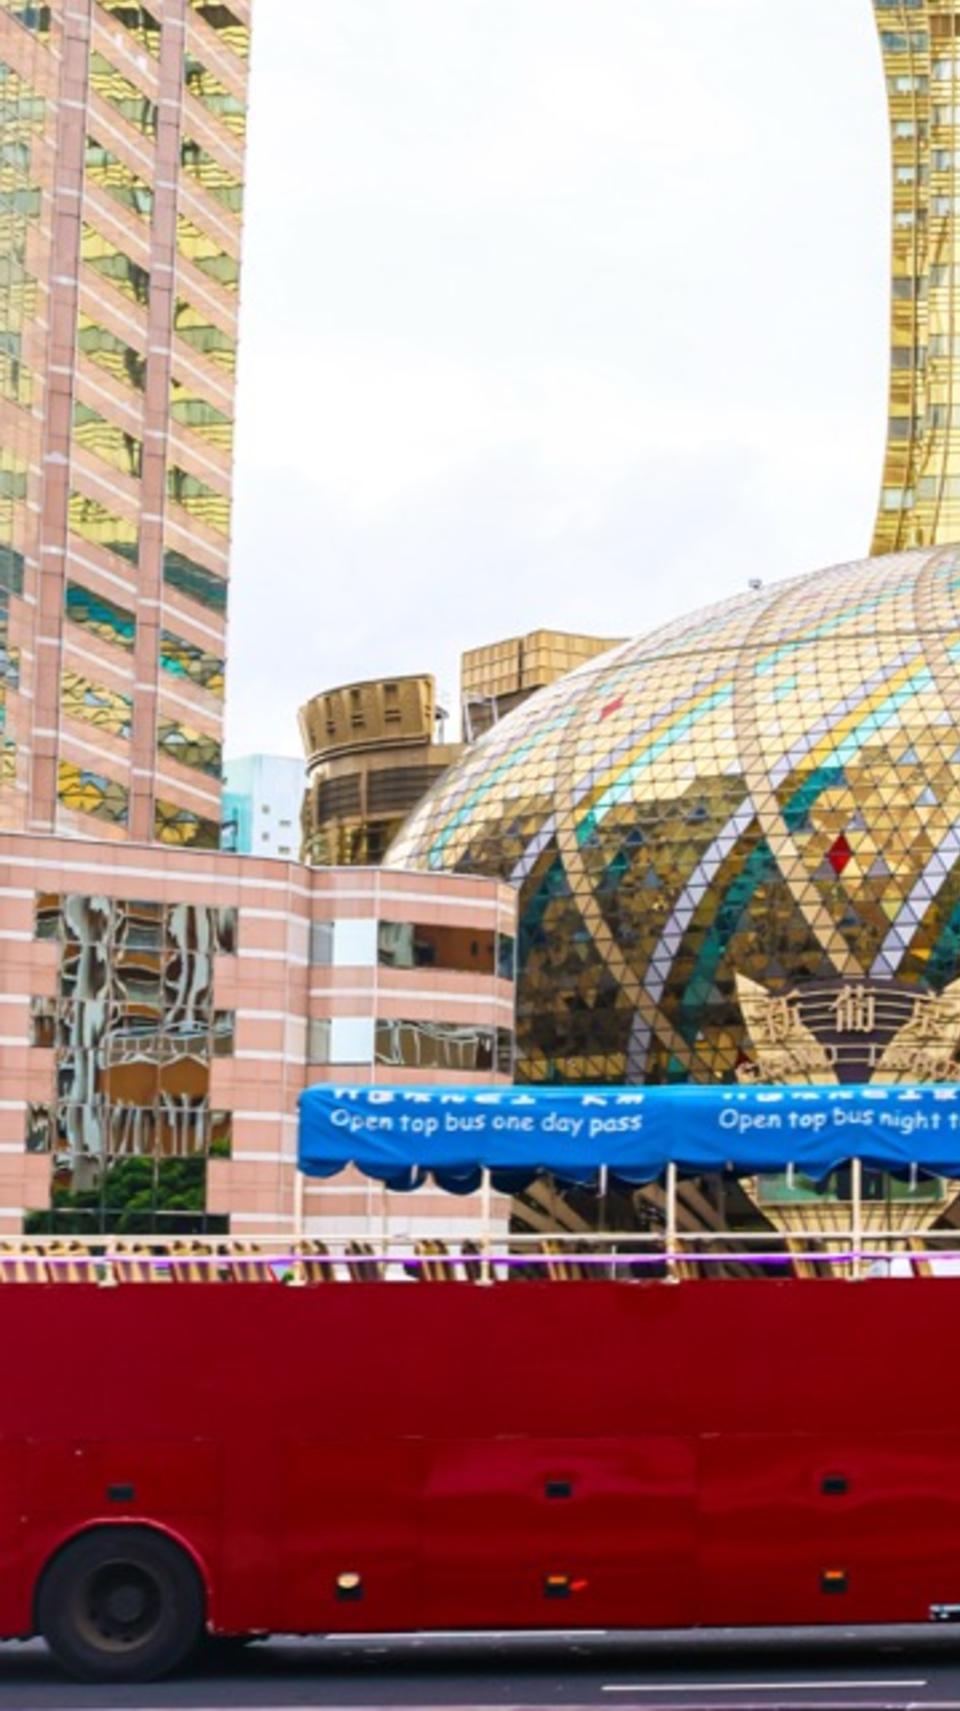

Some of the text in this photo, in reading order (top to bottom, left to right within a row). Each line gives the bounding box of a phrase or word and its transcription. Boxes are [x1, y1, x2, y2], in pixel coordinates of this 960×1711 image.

[329, 1108, 643, 1137] Open top bus one day pass
[718, 1108, 781, 1133] Open
[788, 1111, 827, 1132] top
[832, 1106, 874, 1127] bus
[878, 1110, 941, 1135] night
